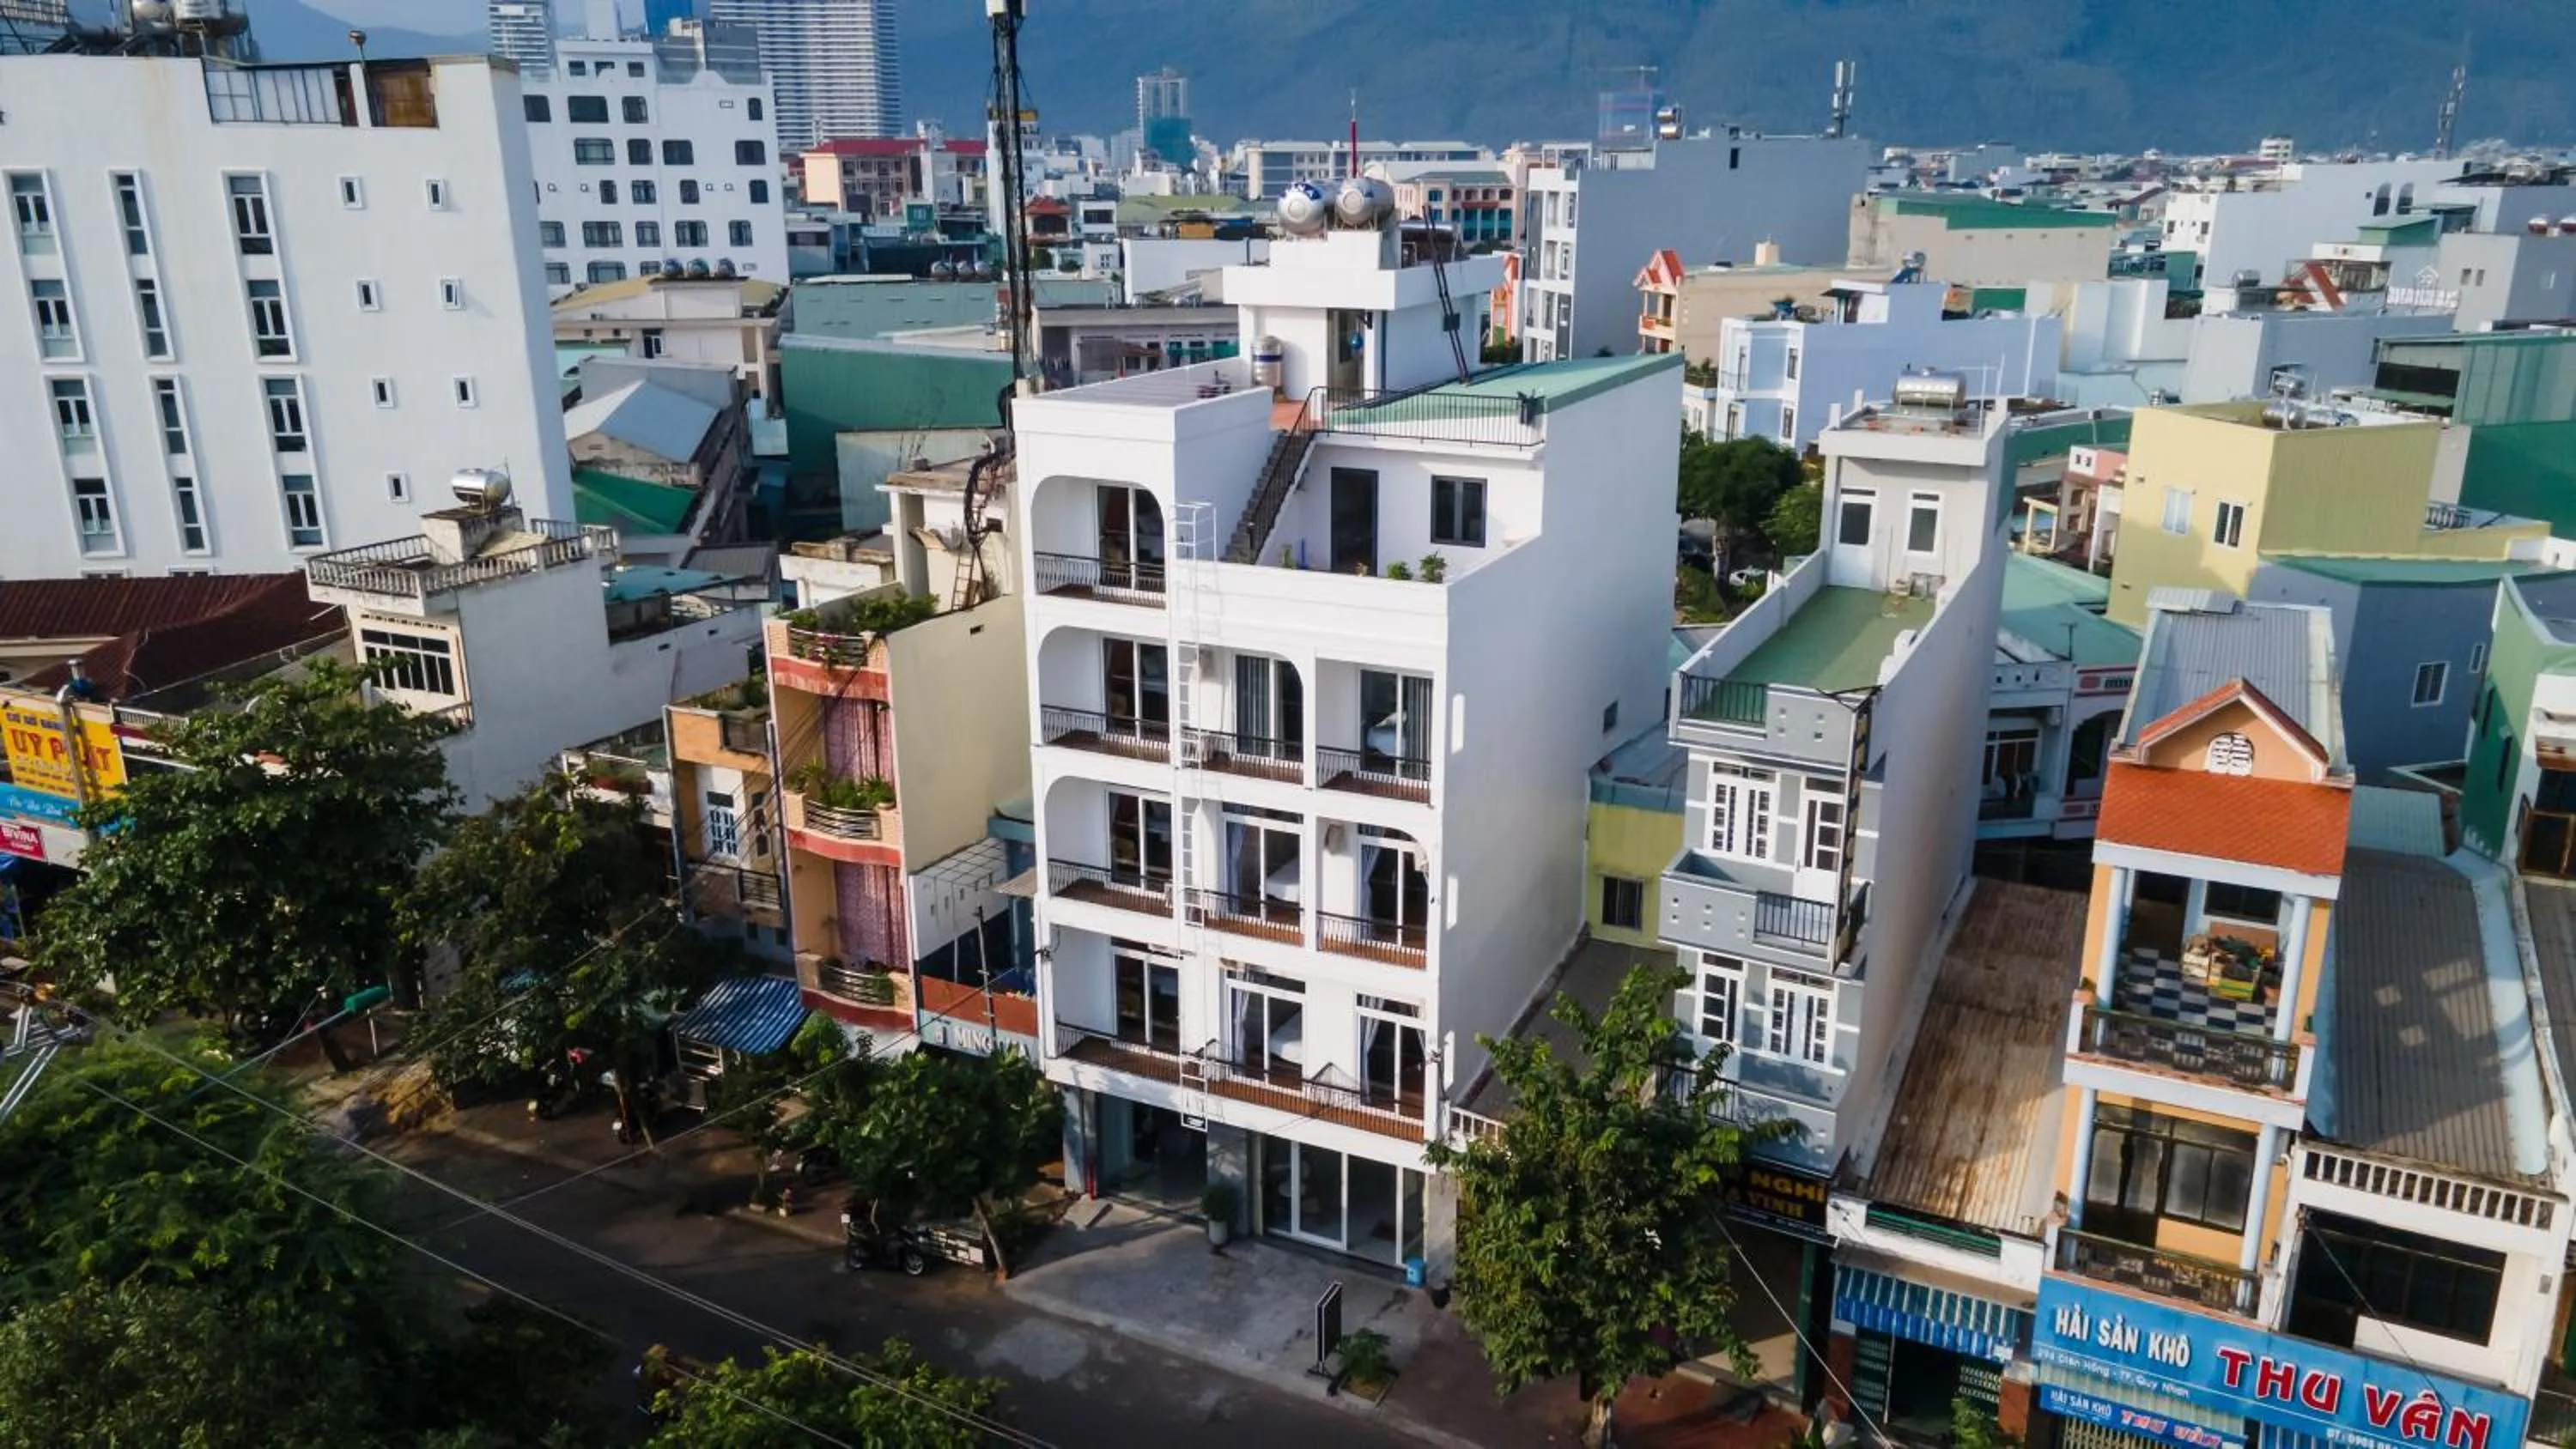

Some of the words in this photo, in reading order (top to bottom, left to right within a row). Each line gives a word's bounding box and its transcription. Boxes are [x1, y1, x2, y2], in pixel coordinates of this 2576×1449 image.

[2055, 1302, 2089, 1341] HẢI
[2098, 1313, 2139, 1354] SẢN
[2148, 1332, 2190, 1367] KHÔ
[2216, 1346, 2342, 1415] THU
[2364, 1383, 2491, 1448] VÂN
